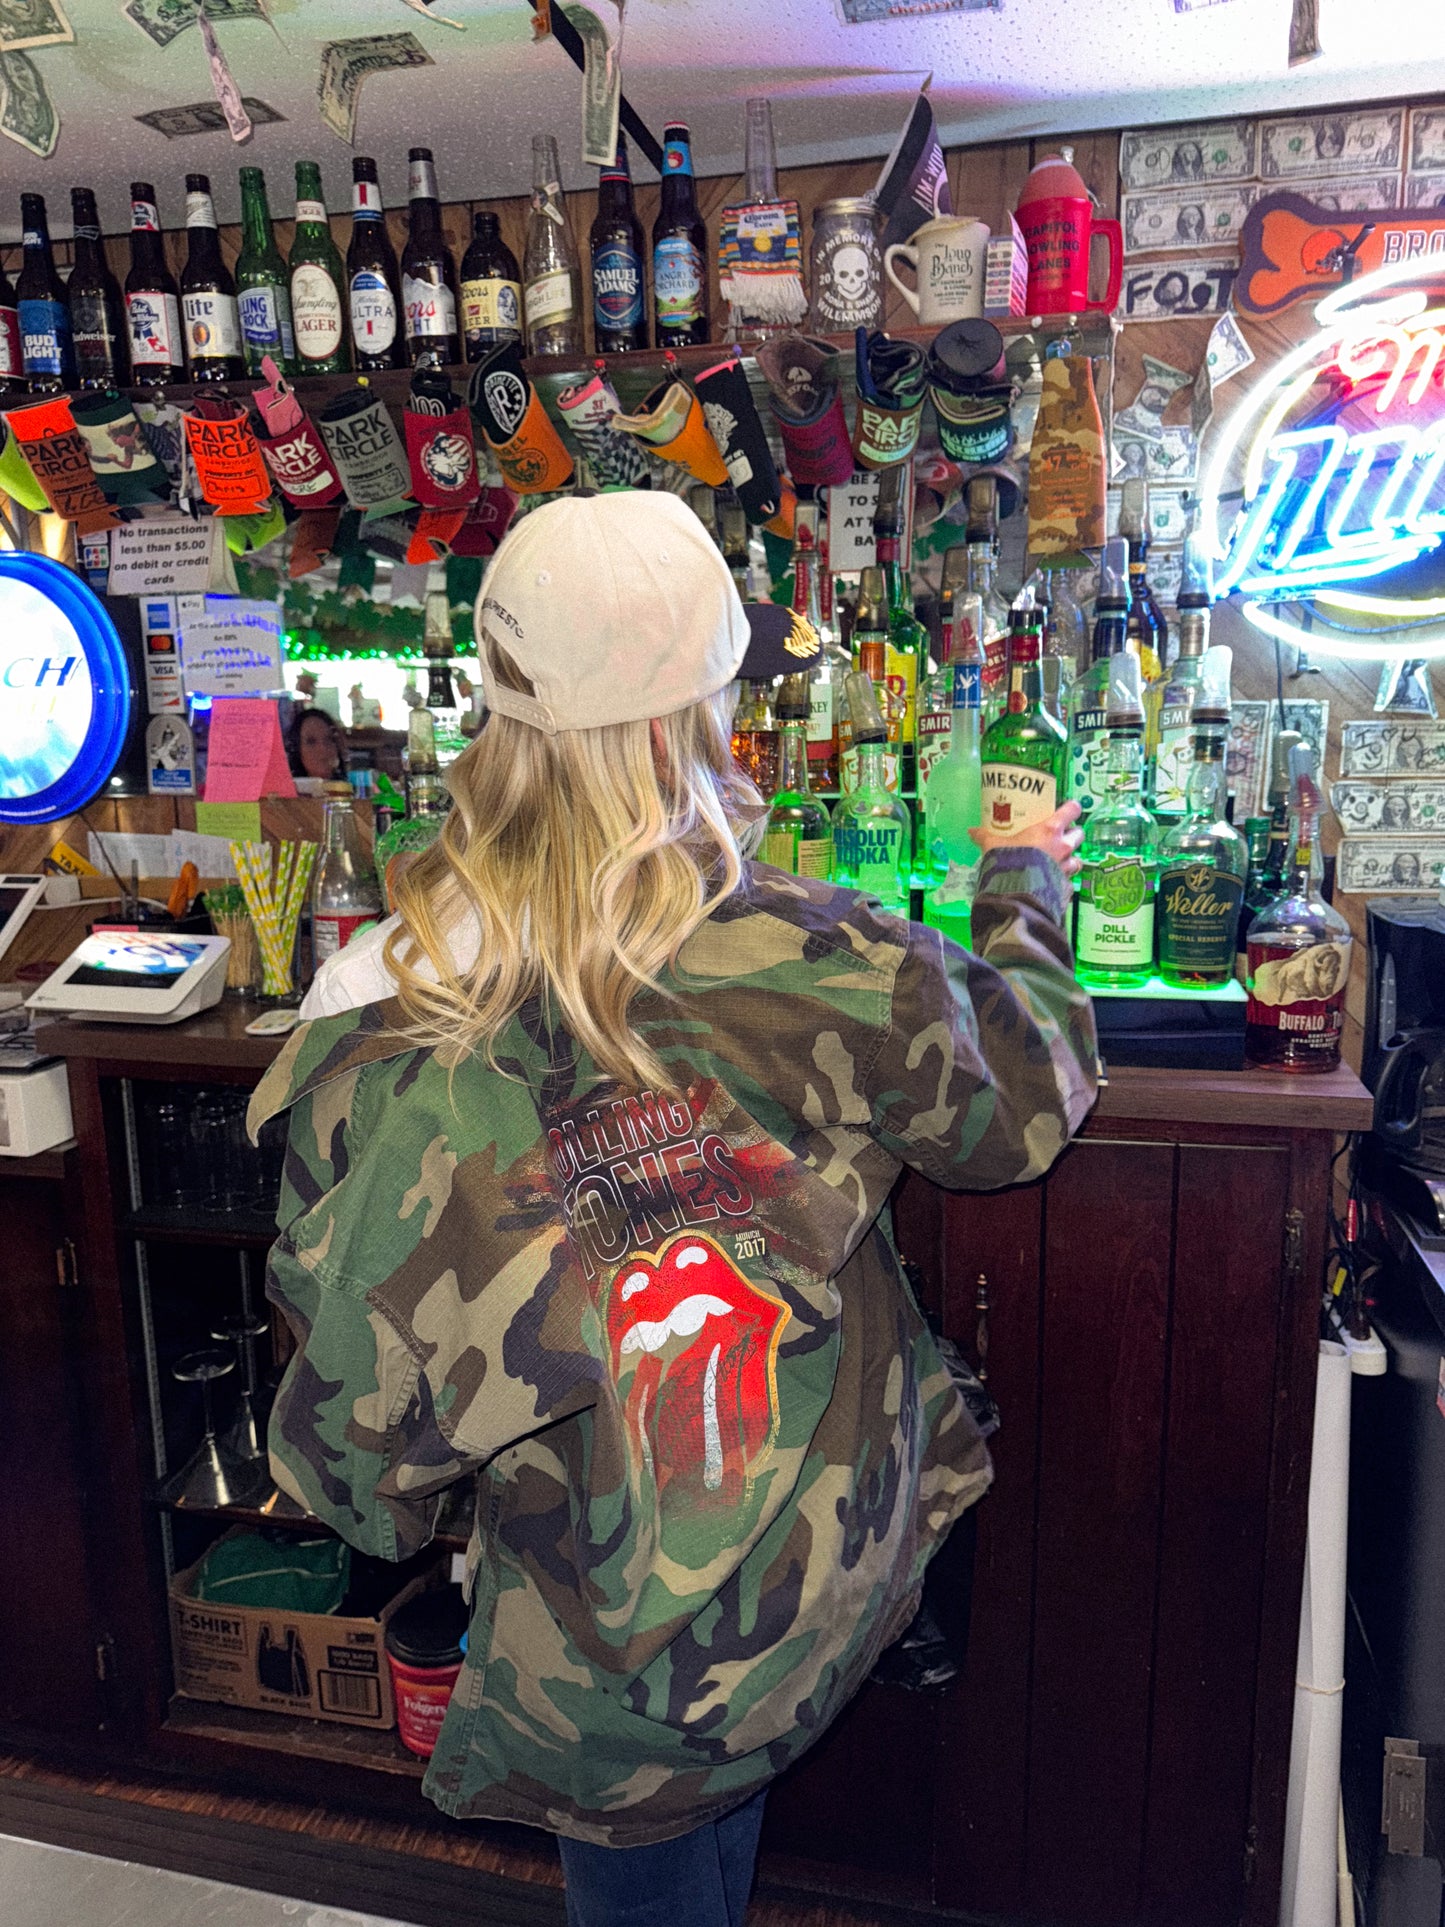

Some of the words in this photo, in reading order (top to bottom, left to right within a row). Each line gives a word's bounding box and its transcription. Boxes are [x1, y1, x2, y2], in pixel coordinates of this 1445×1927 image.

[593, 268, 639, 283] SAMUEL
[597, 279, 636, 296] ADAMS
[184, 298, 213, 320] Lite
[296, 320, 337, 332] LAGER
[25, 335, 54, 347] BUD
[187, 419, 250, 443] PARK
[322, 413, 386, 446] PARK
[189, 437, 257, 460] CIRCLE
[329, 429, 394, 461] CIRCLE
[32, 452, 90, 477] CIRCL
[851, 473, 870, 485] BE
[848, 495, 867, 506] TO
[844, 517, 863, 528] AT
[119, 527, 135, 538] No
[137, 524, 209, 538] transactions
[120, 544, 143, 555] less
[145, 542, 171, 553] than
[175, 540, 205, 552] $5.00
[854, 536, 874, 547] BA
[114, 563, 128, 572] on
[131, 559, 157, 571] debit
[160, 559, 173, 569] or
[176, 555, 209, 568] credit
[144, 574, 175, 586] cards
[153, 666, 175, 675] VISA
[836, 847, 890, 866] VODKA
[1165, 885, 1234, 916] Weller
[1103, 924, 1129, 934] DILL
[1095, 934, 1136, 944] PICKLE
[1278, 1011, 1325, 1031] BUFFALO
[735, 1230, 761, 1243] MUNICH
[734, 1237, 766, 1261] 2017
[176, 1610, 241, 1637] T-SHIRT
